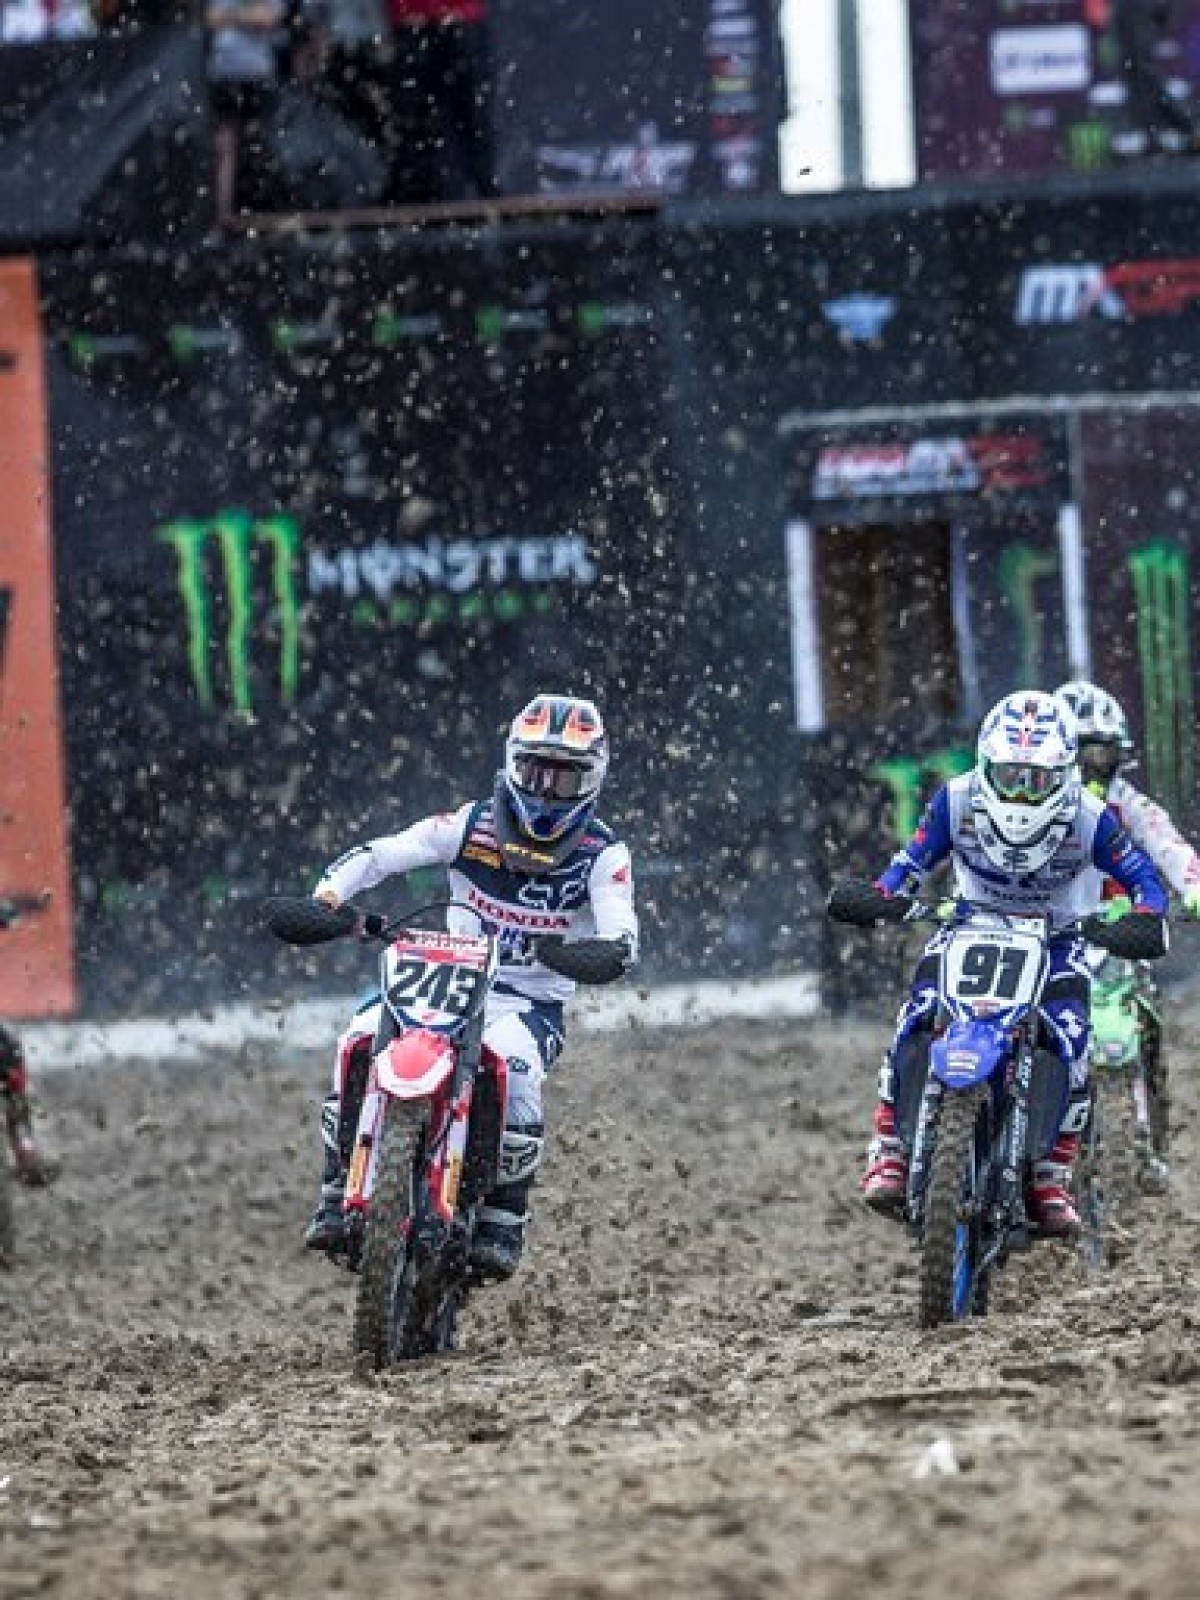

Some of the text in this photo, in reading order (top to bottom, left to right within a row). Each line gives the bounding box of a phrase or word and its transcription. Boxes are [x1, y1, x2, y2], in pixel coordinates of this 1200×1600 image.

[308, 536, 598, 599] MONSTER
[467, 888, 570, 930] HONDA
[387, 958, 489, 1017] 243
[957, 943, 1029, 999] 91
